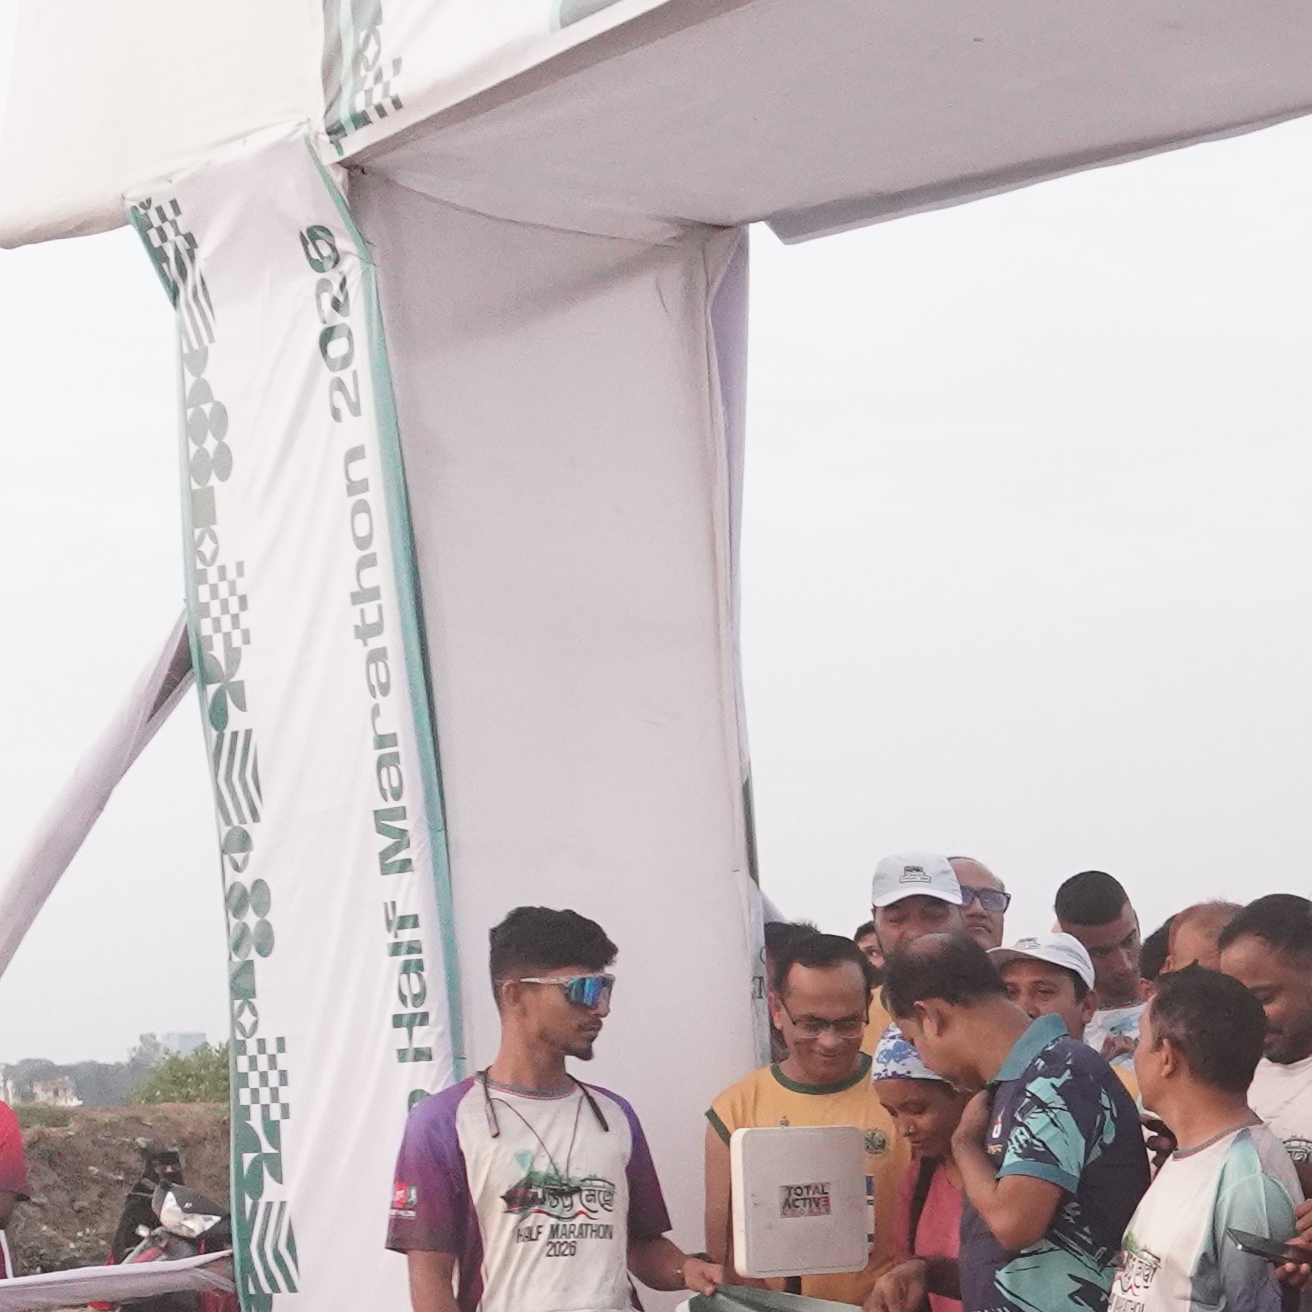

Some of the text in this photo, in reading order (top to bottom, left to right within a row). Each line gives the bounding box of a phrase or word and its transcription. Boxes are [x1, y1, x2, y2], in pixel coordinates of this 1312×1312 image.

[299, 224, 362, 423] 2026
[343, 443, 414, 877] Marathon
[383, 900, 433, 1064] Half
[546, 1241, 578, 1257] 2026
[549, 1223, 614, 1240] MARATHON
